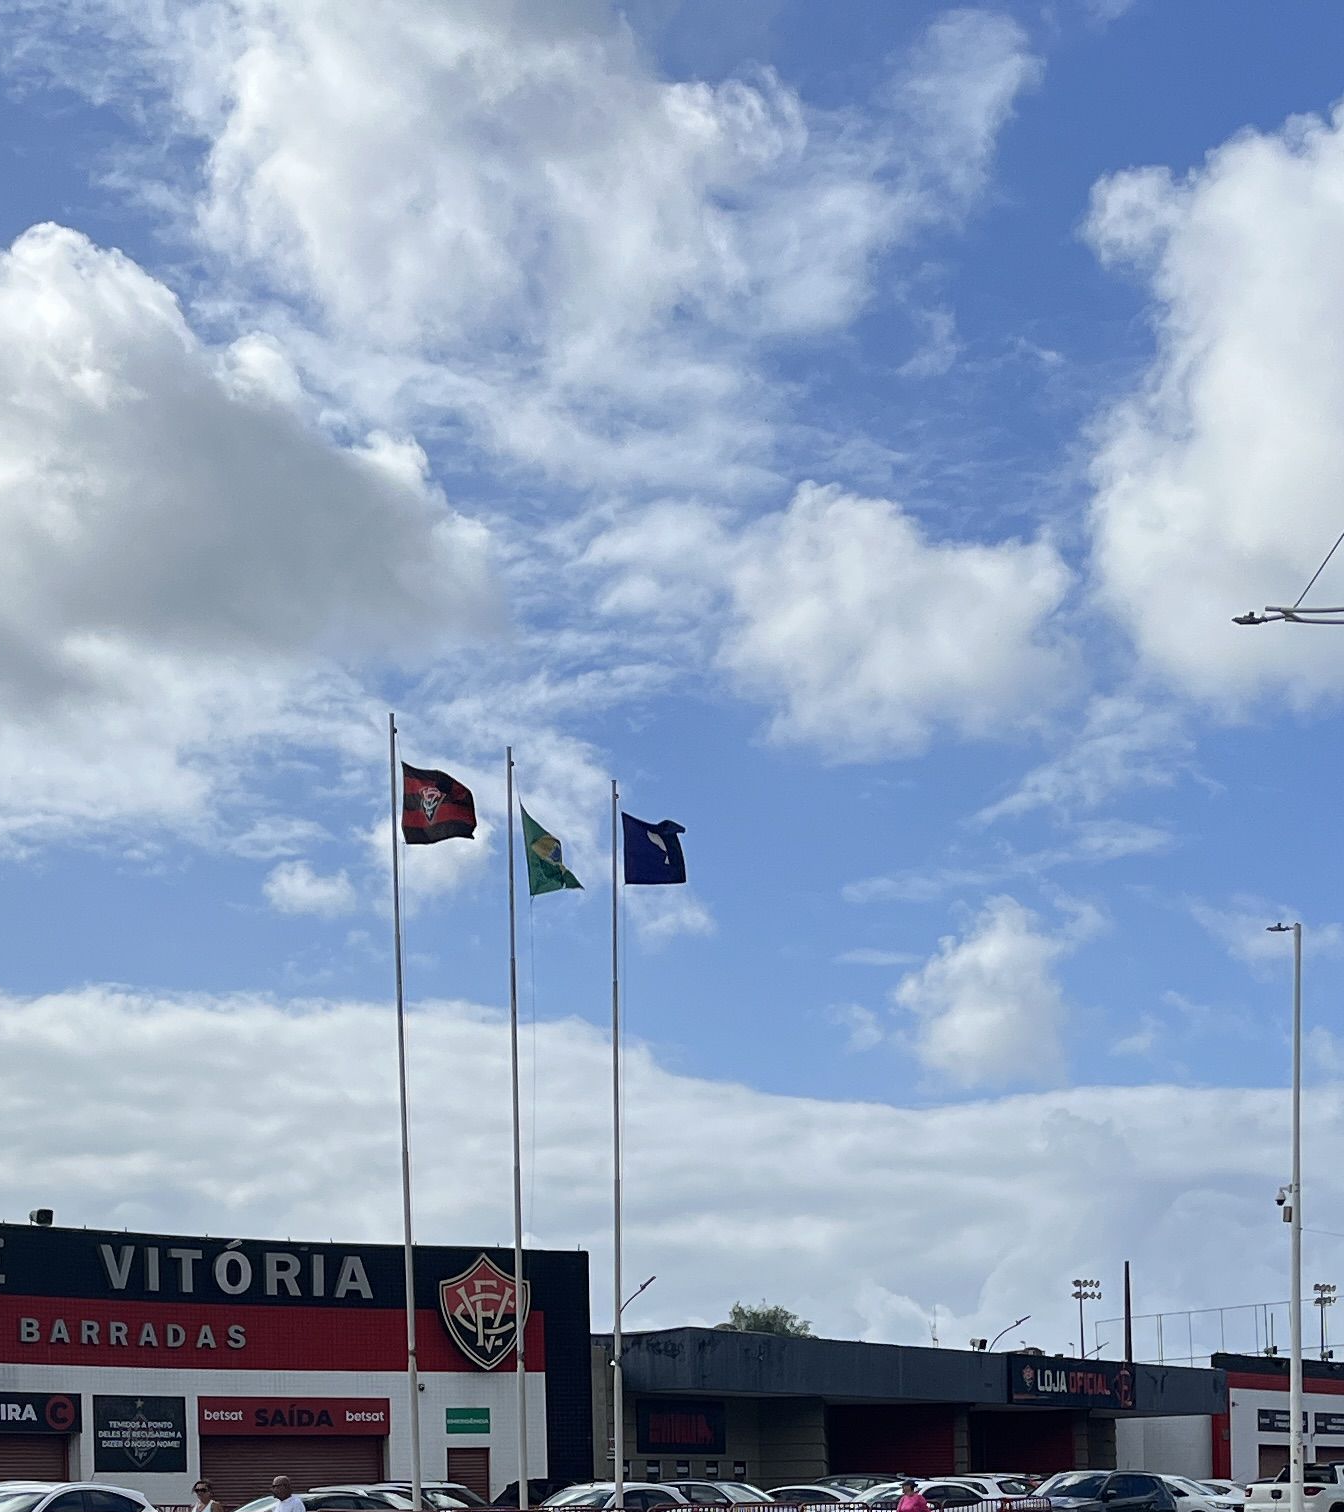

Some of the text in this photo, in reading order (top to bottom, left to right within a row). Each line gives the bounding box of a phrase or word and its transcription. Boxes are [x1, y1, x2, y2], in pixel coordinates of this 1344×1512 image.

[100, 1239, 374, 1299] VITÓRIA
[19, 1317, 247, 1349] BARRADAS
[1037, 1368, 1111, 1396] LOJA OFICIAL
[108, 1421, 173, 1429] TEMIDOS A PONTO
[204, 1404, 385, 1427] betsat SAÍDA betsat
